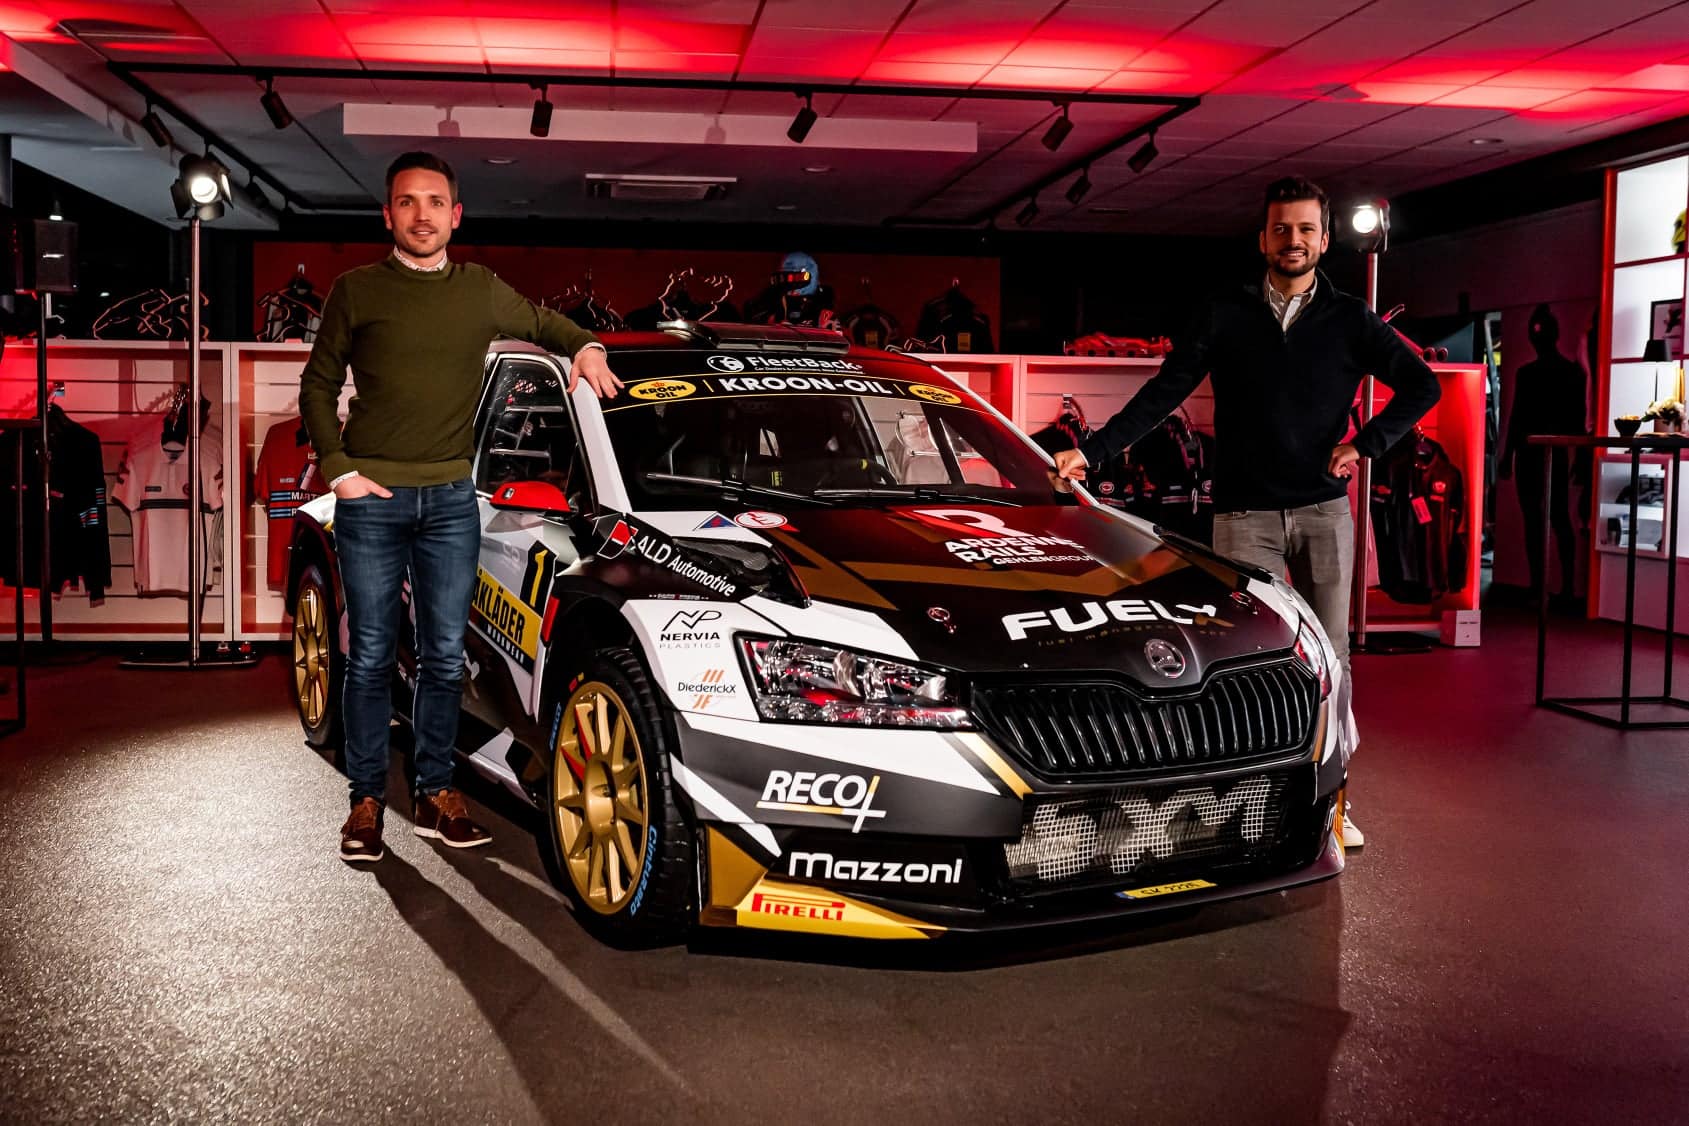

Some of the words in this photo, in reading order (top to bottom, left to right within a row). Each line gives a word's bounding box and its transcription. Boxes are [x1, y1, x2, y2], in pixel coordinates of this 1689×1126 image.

[745, 356, 857, 370] FleetBack
[638, 385, 688, 395] KROON
[718, 376, 893, 394] KROON-OIL
[955, 546, 1045, 563] RAILS
[637, 536, 672, 564] ALD
[667, 554, 736, 597] Automotive
[529, 549, 549, 608] 1
[472, 569, 526, 646] ÅKLÄDER
[660, 632, 721, 642] NERVIA
[751, 892, 846, 921] PIRELLI
